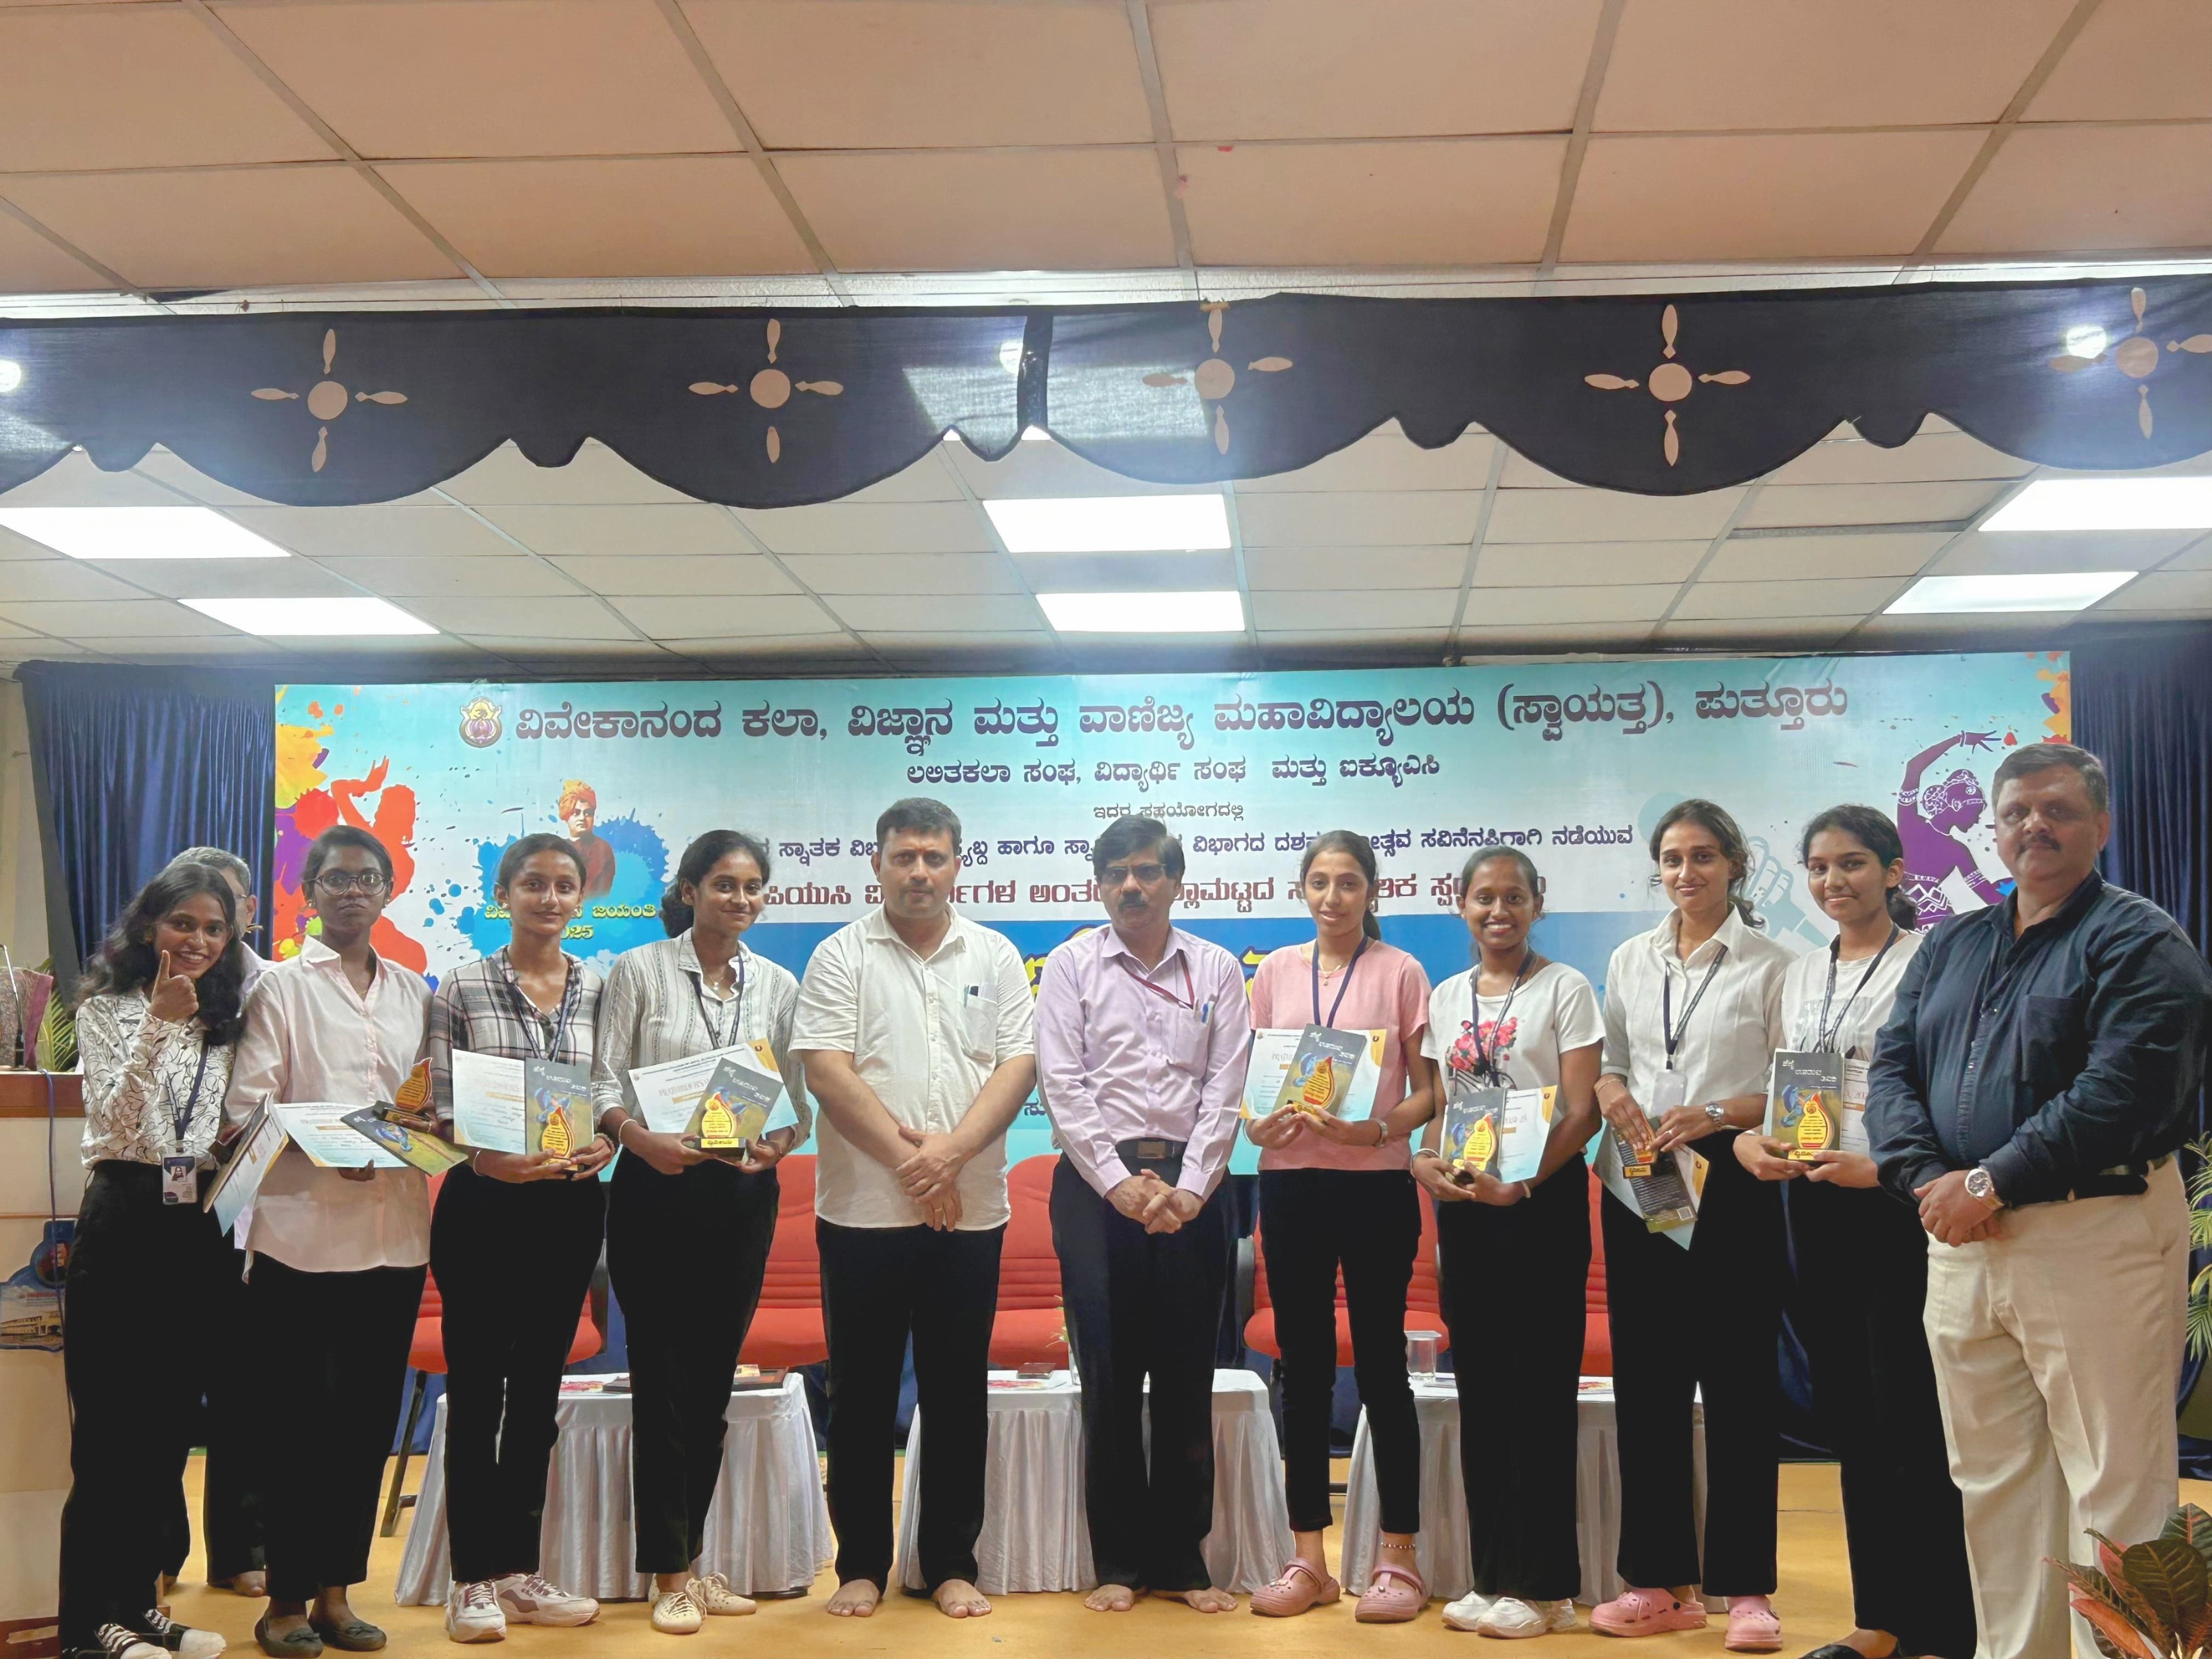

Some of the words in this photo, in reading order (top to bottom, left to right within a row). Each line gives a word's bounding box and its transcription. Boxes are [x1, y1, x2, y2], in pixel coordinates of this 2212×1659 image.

[516, 700, 721, 739] ವಿವೇಕಾನಂದ
[742, 699, 827, 740] ಕಲಾ,
[848, 698, 953, 756] ವಿಜ್ಞಾನ
[974, 697, 1059, 747] ಮತ್ತು
[1079, 696, 1194, 751] ವಾಣಿಜ್ಯ
[1214, 687, 1474, 747] ಮಹಾವಿದ್ಯಾಲಯ
[1498, 681, 1674, 741] (ಸ್ವಾಯತ್ತ),
[1695, 678, 1847, 730] ಪುತ್ತೂರು
[908, 759, 1011, 784] ಲಲಿತಕಲಾ
[1024, 758, 1081, 786] ಸಂಘ,
[1094, 761, 1181, 793] ವಿದ್ಯಾರ್ಥಿ
[1194, 757, 1246, 783] ಸಂಘ
[1272, 754, 1327, 786] ಮತ್ತು
[1340, 753, 1440, 788] ಐಕ್ಯೂಎಸಿ
[1093, 803, 1131, 819] ಇದರ
[779, 838, 840, 866] ಸ್ನಾತಕ
[997, 836, 1055, 855] ಹಾಗೂ
[1193, 832, 1265, 856] ವಿಭಾಗದ
[1421, 827, 1543, 848] ಸವಿನೆನಪಿಗಾಗಿ
[1552, 825, 1633, 845] ನಡೆಯುವ
[763, 882, 851, 905] ಪಿಯುಸಿ
